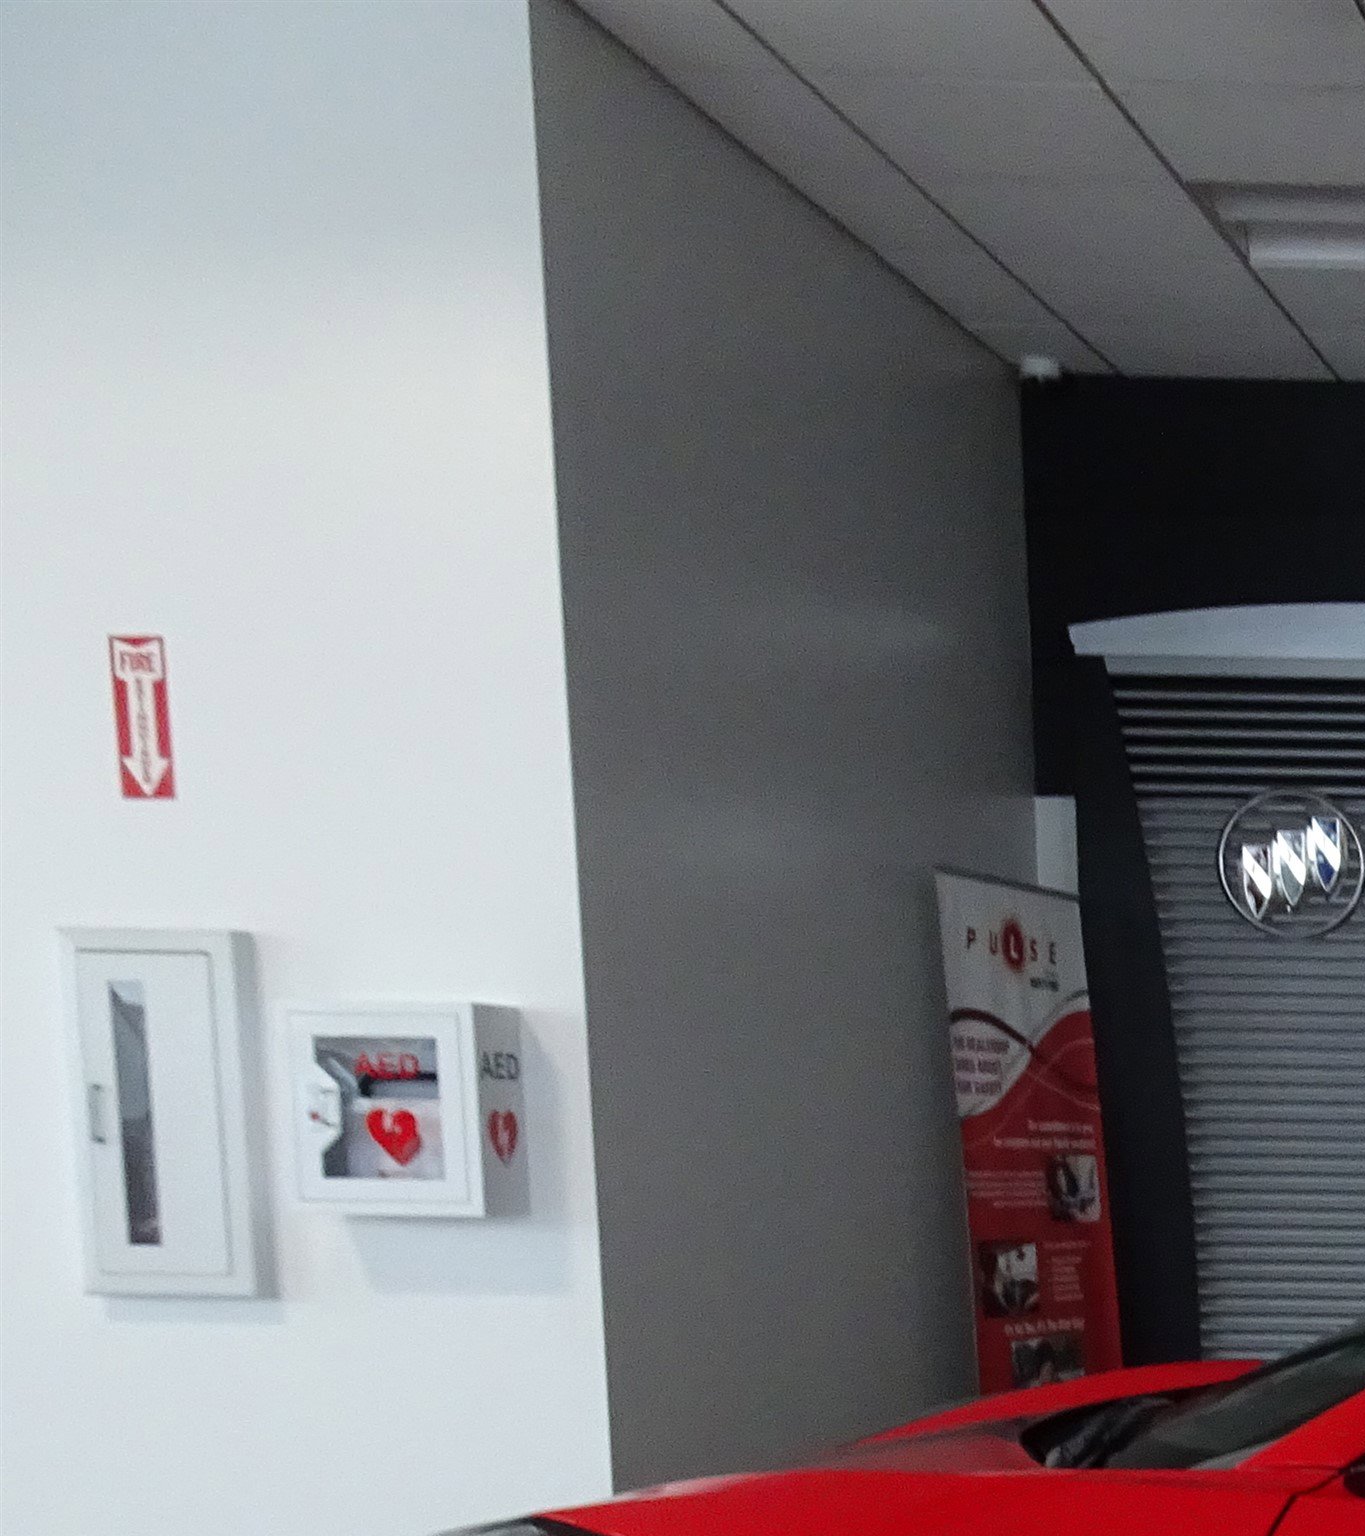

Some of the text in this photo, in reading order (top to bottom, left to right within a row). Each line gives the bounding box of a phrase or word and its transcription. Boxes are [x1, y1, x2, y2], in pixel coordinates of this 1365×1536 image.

[119, 651, 155, 673] FIRE
[966, 926, 1057, 966] PULSE
[354, 1052, 421, 1080] AED
[481, 1051, 521, 1080] AED
